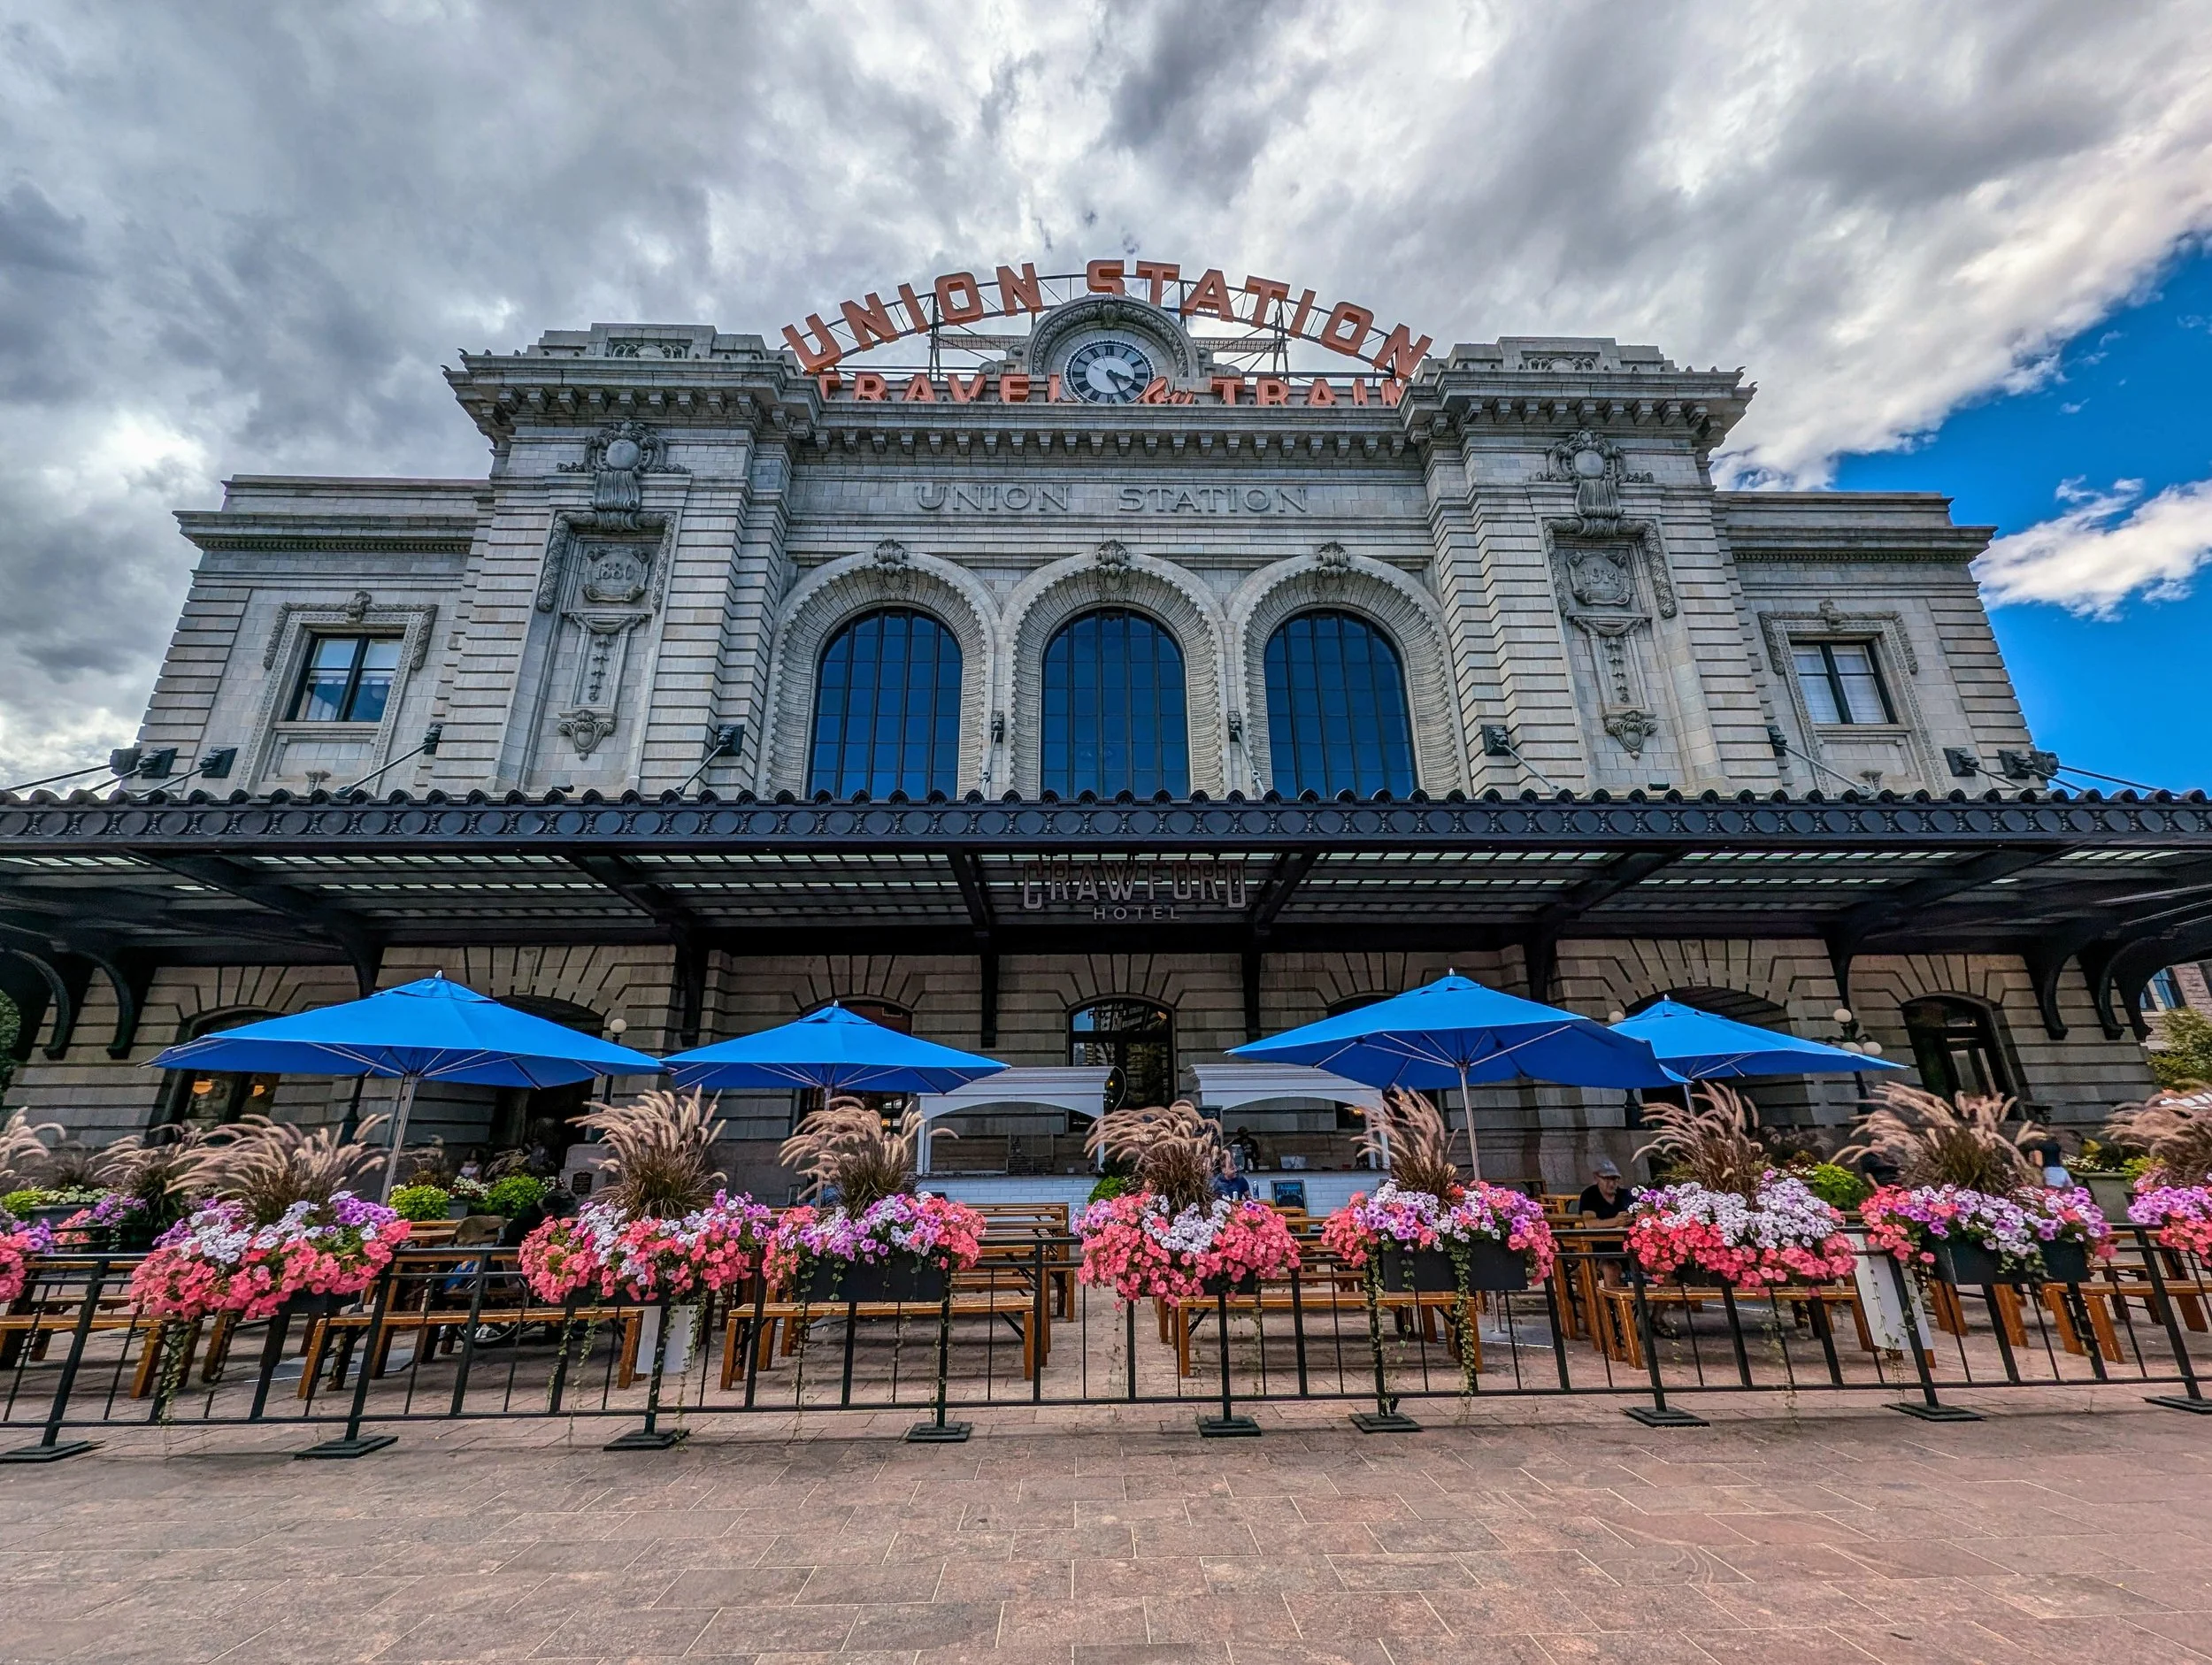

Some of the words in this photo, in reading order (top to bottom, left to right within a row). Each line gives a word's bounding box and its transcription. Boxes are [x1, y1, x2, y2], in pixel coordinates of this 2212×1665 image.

[781, 262, 1043, 372] UNION
[1087, 259, 1433, 379] STATION
[1210, 375, 1406, 406] TRAIN
[916, 486, 1069, 510] UNION
[1118, 487, 1307, 513] STATION
[595, 563, 635, 580] 1880
[1023, 860, 1248, 909] CRAWFORD
[1093, 907, 1181, 921] HOTEL
